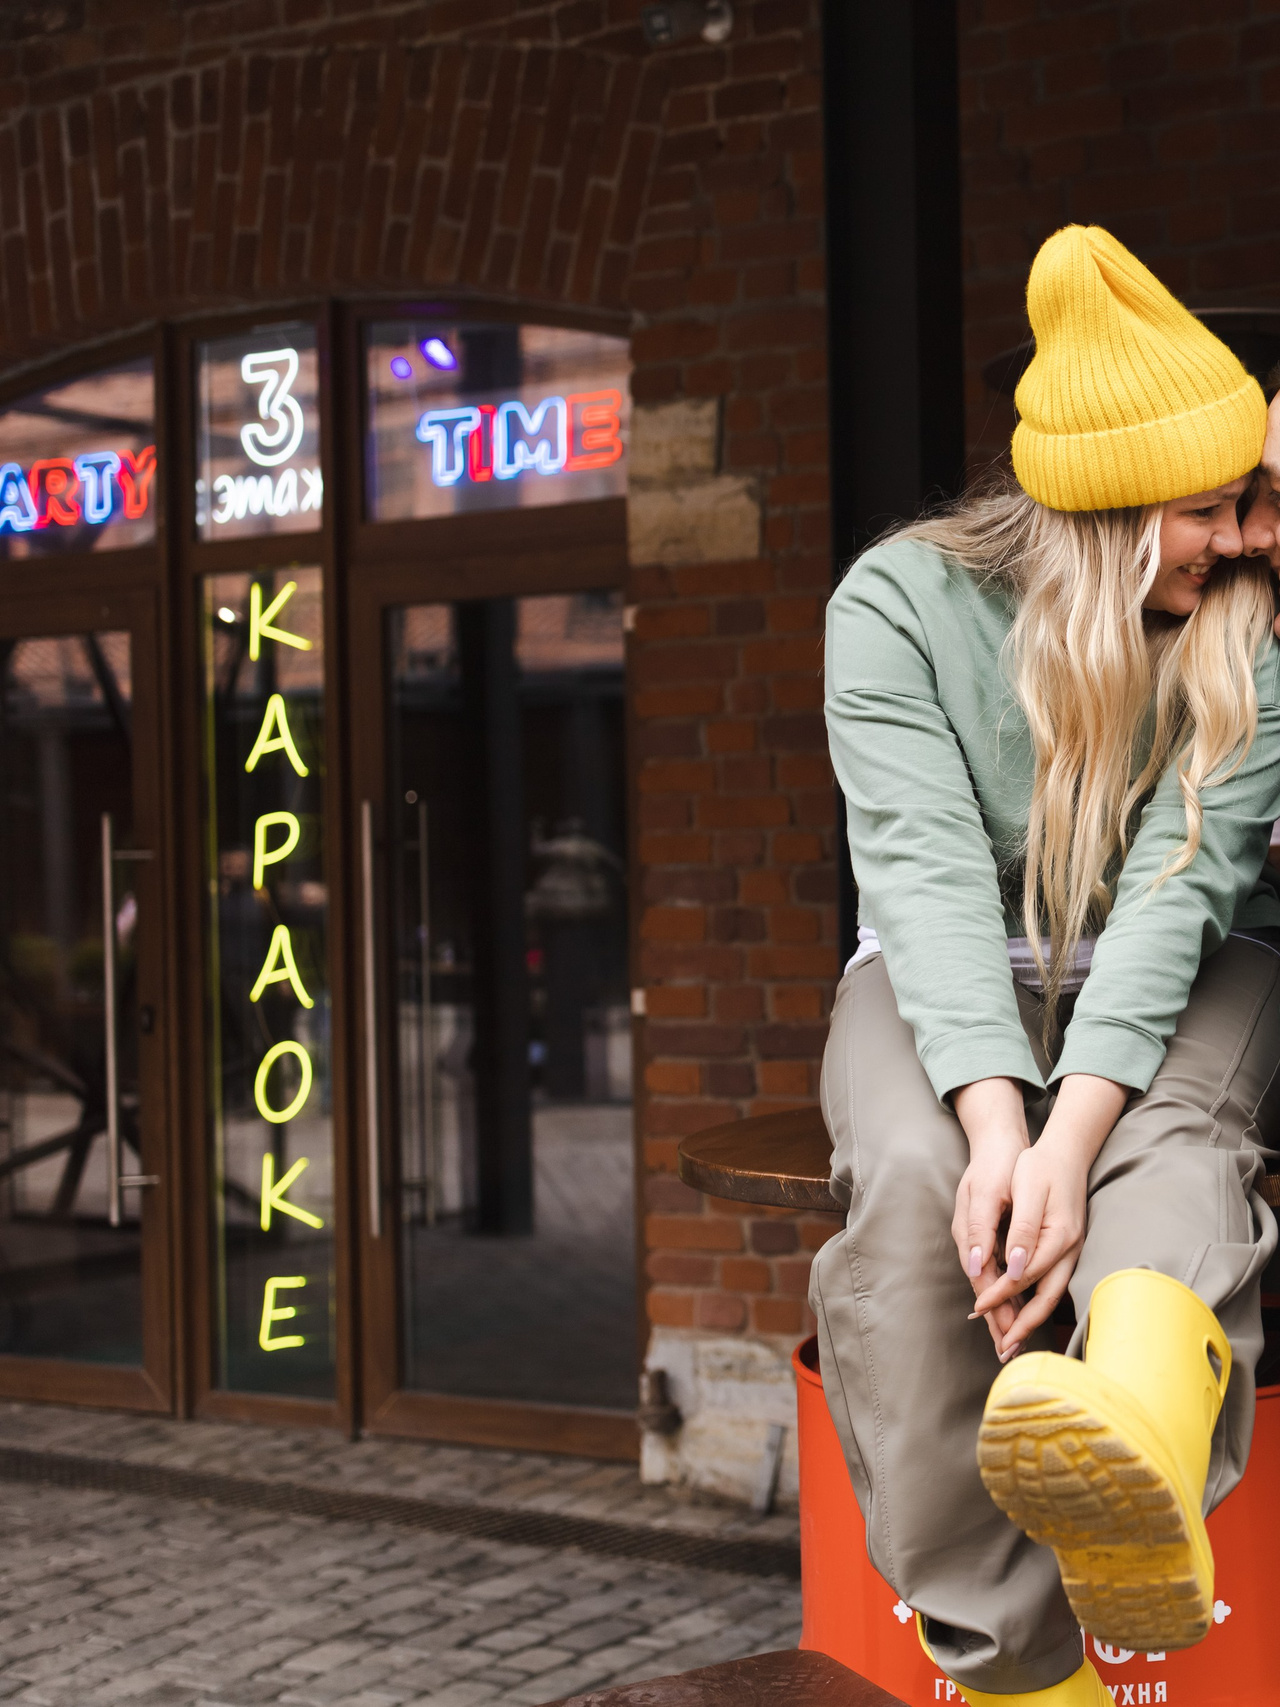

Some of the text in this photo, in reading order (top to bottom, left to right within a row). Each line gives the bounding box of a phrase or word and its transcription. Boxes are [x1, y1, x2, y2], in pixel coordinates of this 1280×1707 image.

[240, 348, 304, 467] 3
[416, 389, 623, 487] TIME
[244, 580, 324, 1352] КАРАОКЕ
[1106, 1681, 1167, 1706] УХНЯ
